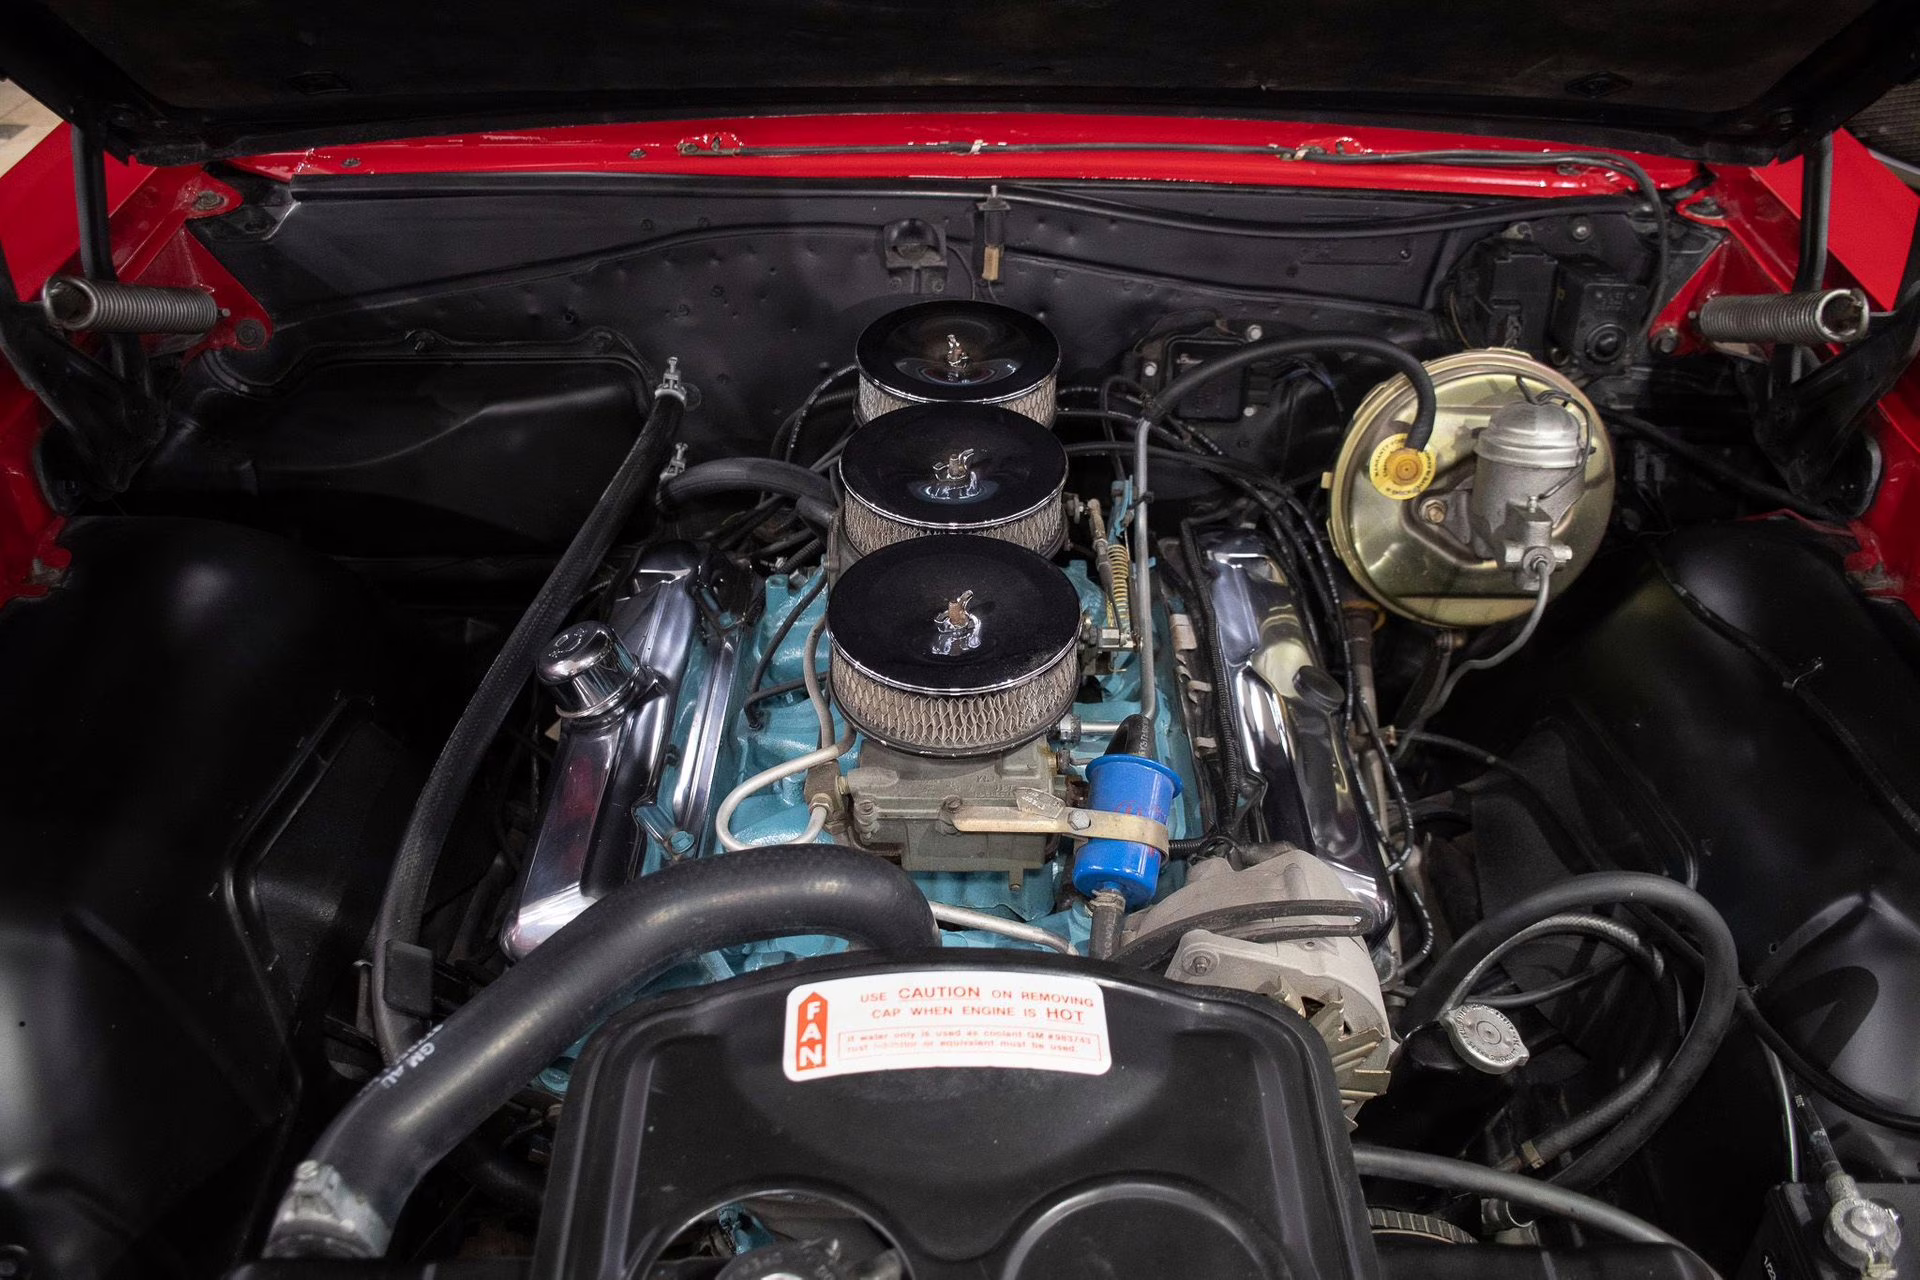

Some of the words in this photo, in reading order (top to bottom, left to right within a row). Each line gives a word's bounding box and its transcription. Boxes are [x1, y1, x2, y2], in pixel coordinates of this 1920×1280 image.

[860, 991, 887, 1003] USE
[898, 986, 981, 999] CAUTION
[991, 989, 1013, 999] ON
[1021, 991, 1094, 1008] REMOVING
[871, 1007, 901, 1020] CAP
[910, 1006, 953, 1017] WHEN
[962, 1006, 1016, 1016] ENGINE
[1024, 1008, 1037, 1018] IS
[1046, 1007, 1085, 1022] HOT
[799, 1001, 823, 1068] FAN
[894, 1031, 915, 1040] only
[936, 1029, 961, 1037] used
[984, 1030, 1023, 1038] coolant
[940, 1039, 994, 1048] equivalent
[1000, 1040, 1026, 1048] must
[1031, 1041, 1045, 1049] be
